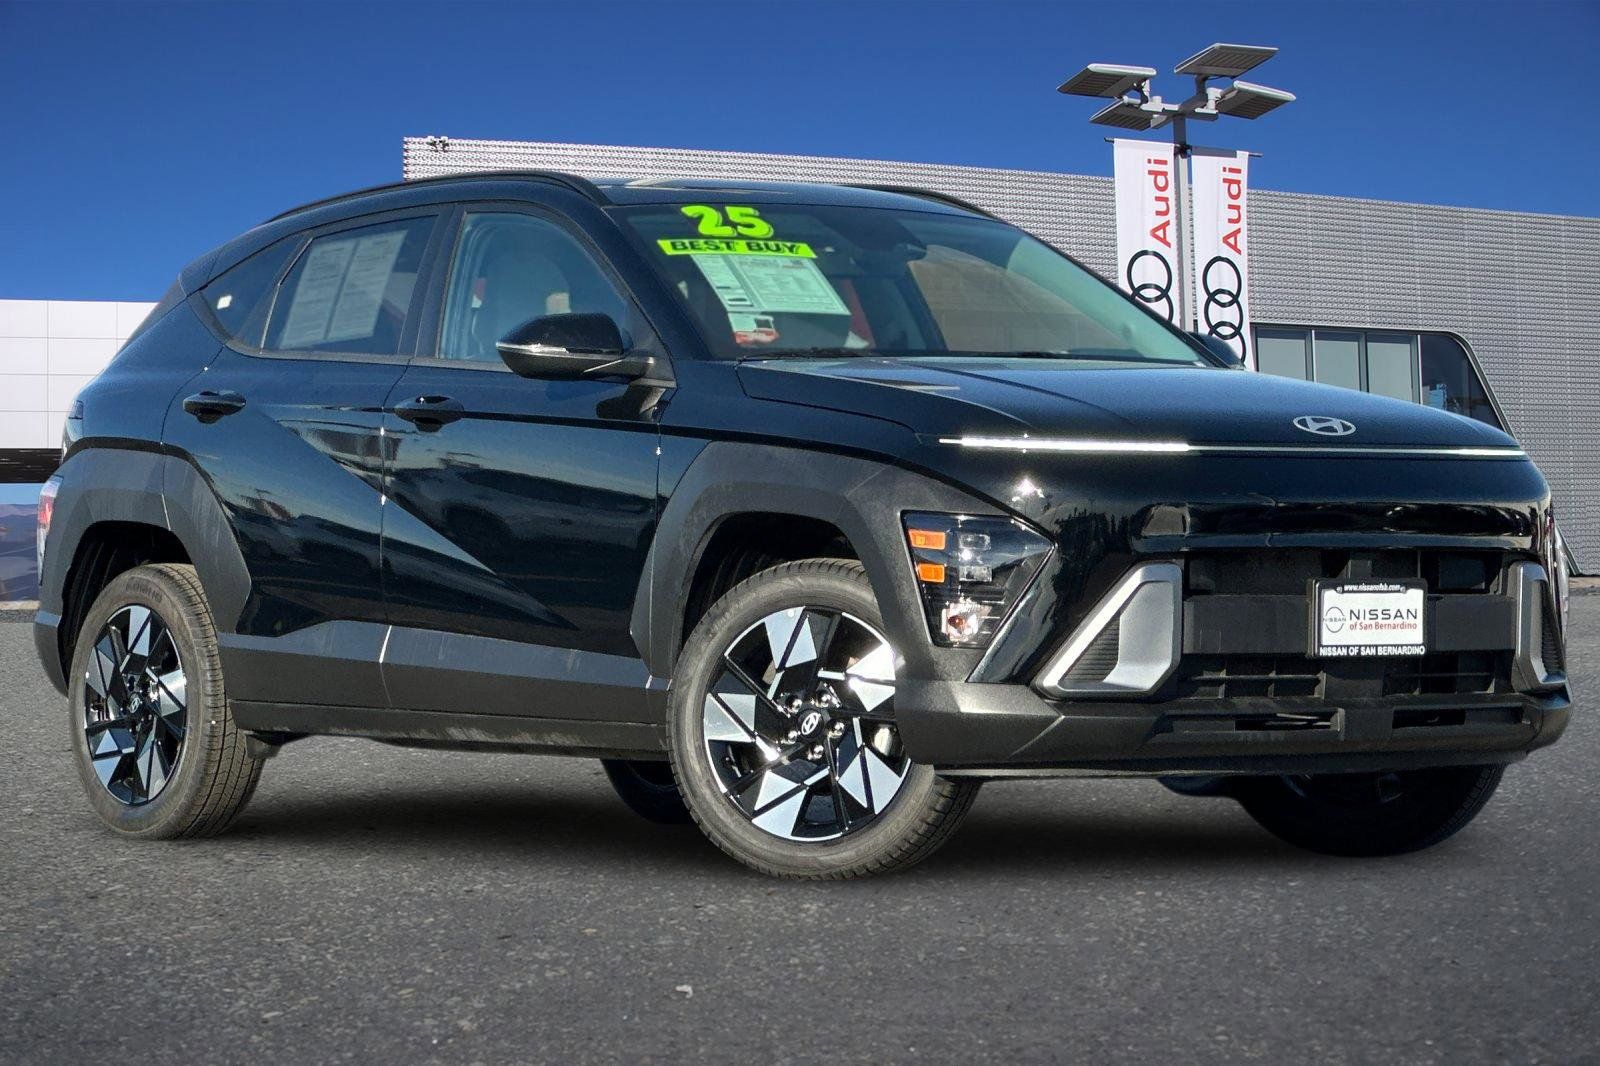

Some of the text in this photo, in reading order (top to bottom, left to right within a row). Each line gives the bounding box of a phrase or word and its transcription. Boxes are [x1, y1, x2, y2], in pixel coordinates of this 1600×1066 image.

[1147, 158, 1171, 248] Audi
[1222, 166, 1242, 255] Audi
[681, 205, 774, 238] 25
[670, 239, 800, 255] BEST BUY
[1349, 608, 1418, 620] NISSAN
[1349, 621, 1418, 630] of San Bernardino
[1319, 645, 1426, 656] NISSAN OF SAN BERNARDINO
